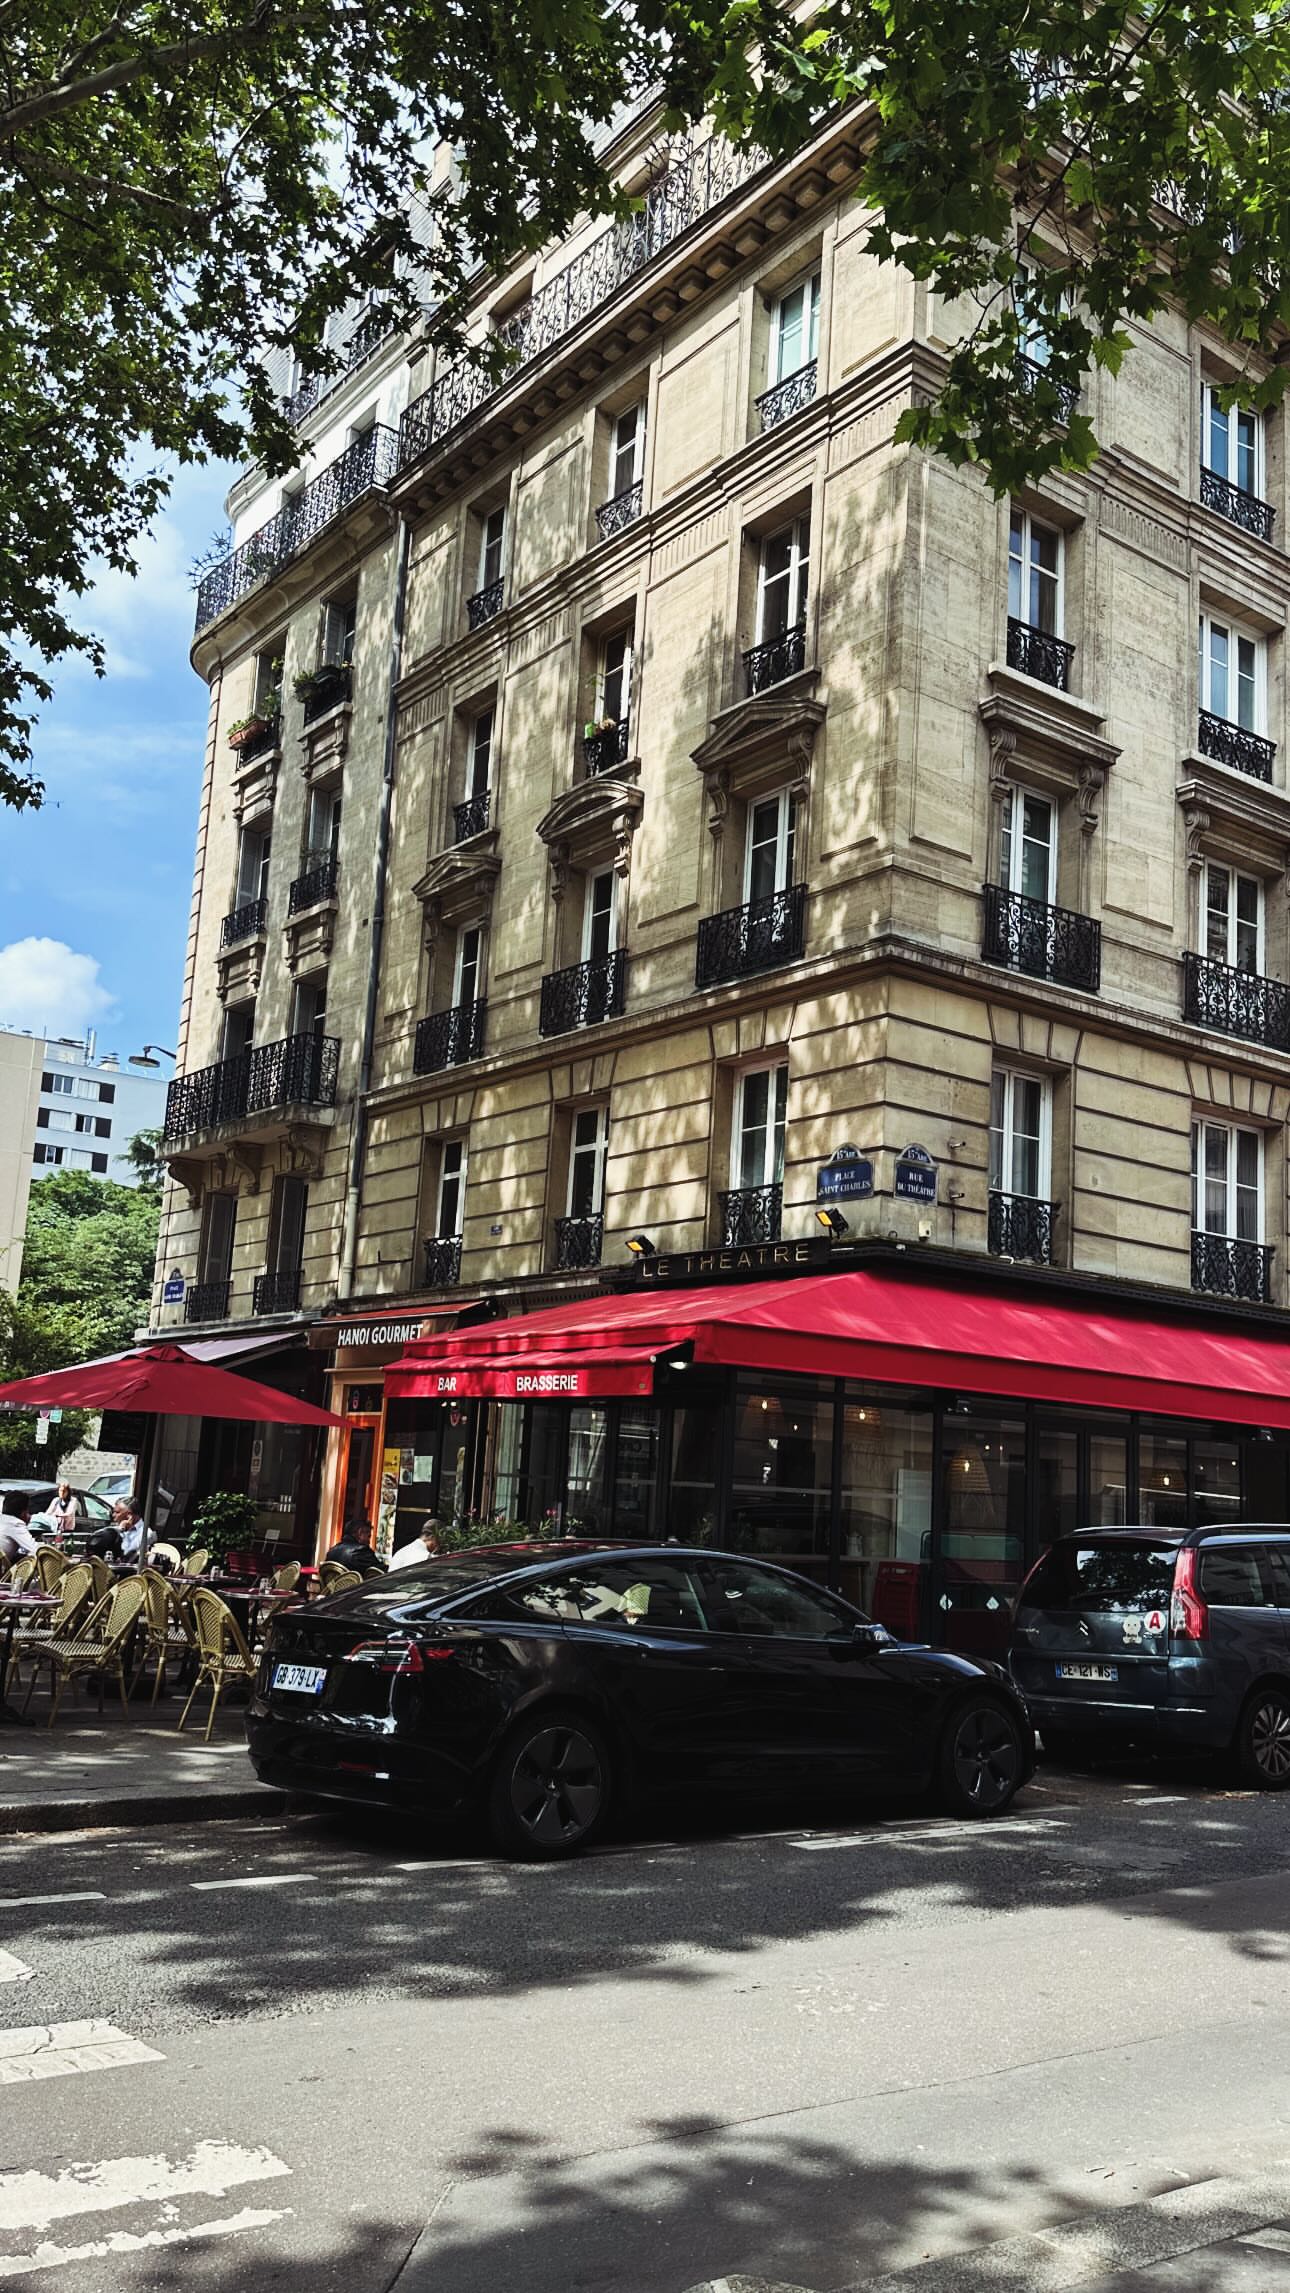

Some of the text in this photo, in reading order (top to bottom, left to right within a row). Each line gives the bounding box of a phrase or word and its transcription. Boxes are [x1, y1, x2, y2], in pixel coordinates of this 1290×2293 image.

[835, 1170, 855, 1181] PLACE
[909, 1171, 923, 1183] RUE
[818, 1181, 871, 1196] SAINT CHARLES
[897, 1182, 906, 1191] DU
[642, 1243, 809, 1277] LE THEATRE
[337, 1323, 424, 1346] HANOI GOURMET
[437, 1377, 457, 1391] BAR
[516, 1374, 578, 1392] BRASSERIE
[1149, 1612, 1161, 1629] A
